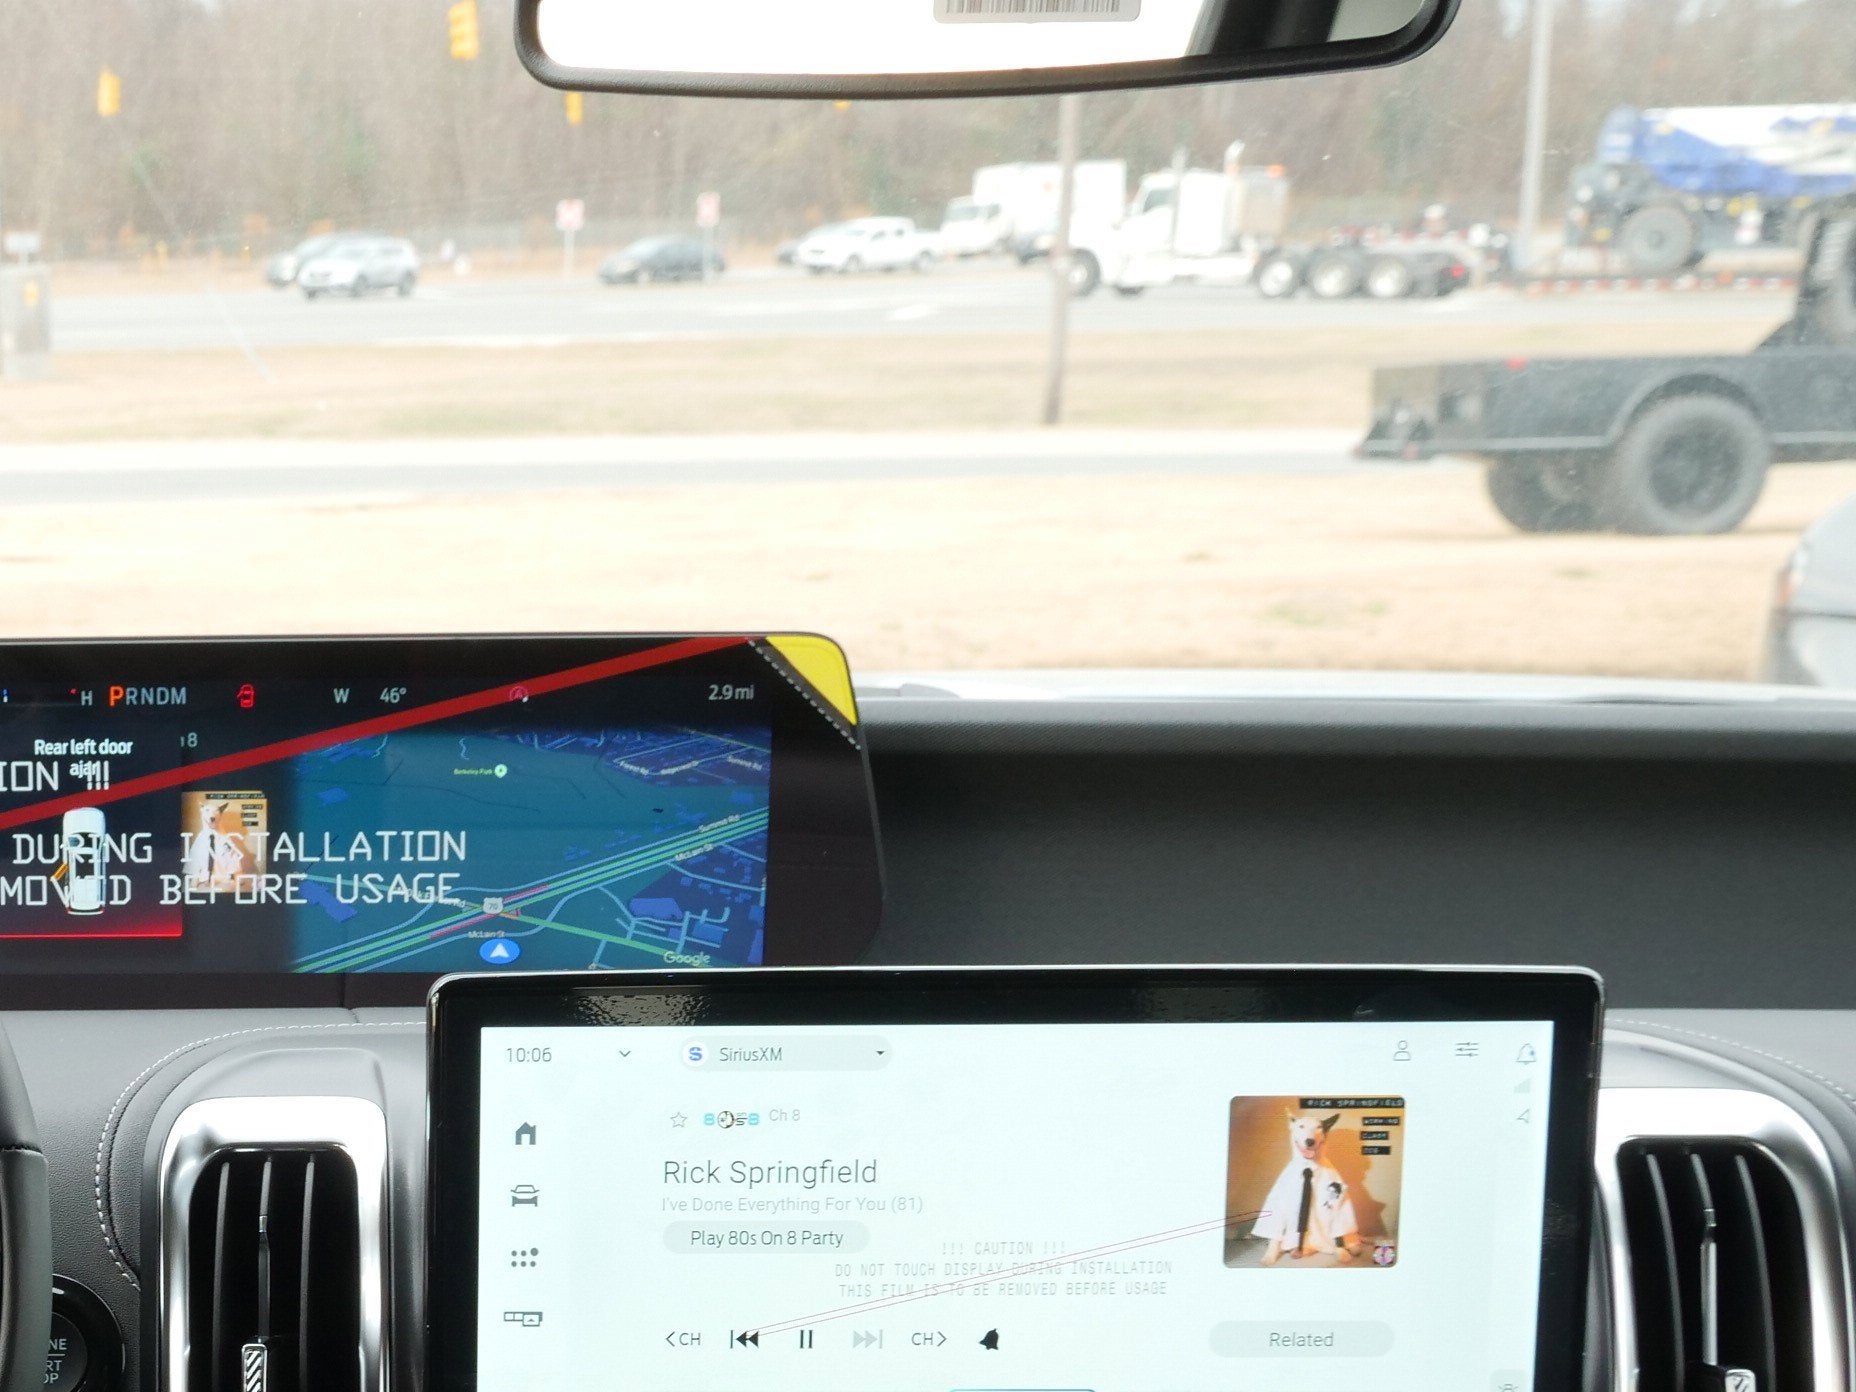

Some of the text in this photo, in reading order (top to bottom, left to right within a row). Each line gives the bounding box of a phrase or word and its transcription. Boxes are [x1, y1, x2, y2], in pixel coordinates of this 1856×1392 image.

[81, 691, 93, 705] H
[334, 687, 407, 703] W 46°
[708, 685, 754, 700] 2.9 mi
[34, 738, 133, 755] Rear left door
[12, 833, 152, 864] DURING
[160, 874, 308, 905] BEFORE
[335, 872, 460, 904] USAGE
[663, 951, 711, 966] Google
[505, 1047, 552, 1063] 10:06
[719, 1047, 783, 1063] SiriusXM
[769, 1108, 801, 1123] Ch 8
[663, 1159, 877, 1189] Rick Springfield
[661, 1196, 924, 1214] I've Done Everything For You (81)
[690, 1230, 844, 1248] Play 80s On 8 Party
[974, 1241, 1033, 1255] CAUTION
[835, 1261, 1173, 1277] DO NOT TOUCH DISPLAY DURING INSTALLATION
[839, 1284, 873, 1297] THIS
[882, 1284, 915, 1297] FILM
[924, 1283, 939, 1297] IS
[973, 1283, 990, 1296] BE
[998, 1282, 1058, 1296] REMOVED
[1066, 1282, 1116, 1296] BEFORE
[1125, 1281, 1168, 1295] USAGE
[679, 1333, 701, 1346] CH
[911, 1333, 934, 1346] CH
[1269, 1332, 1334, 1347] Related
